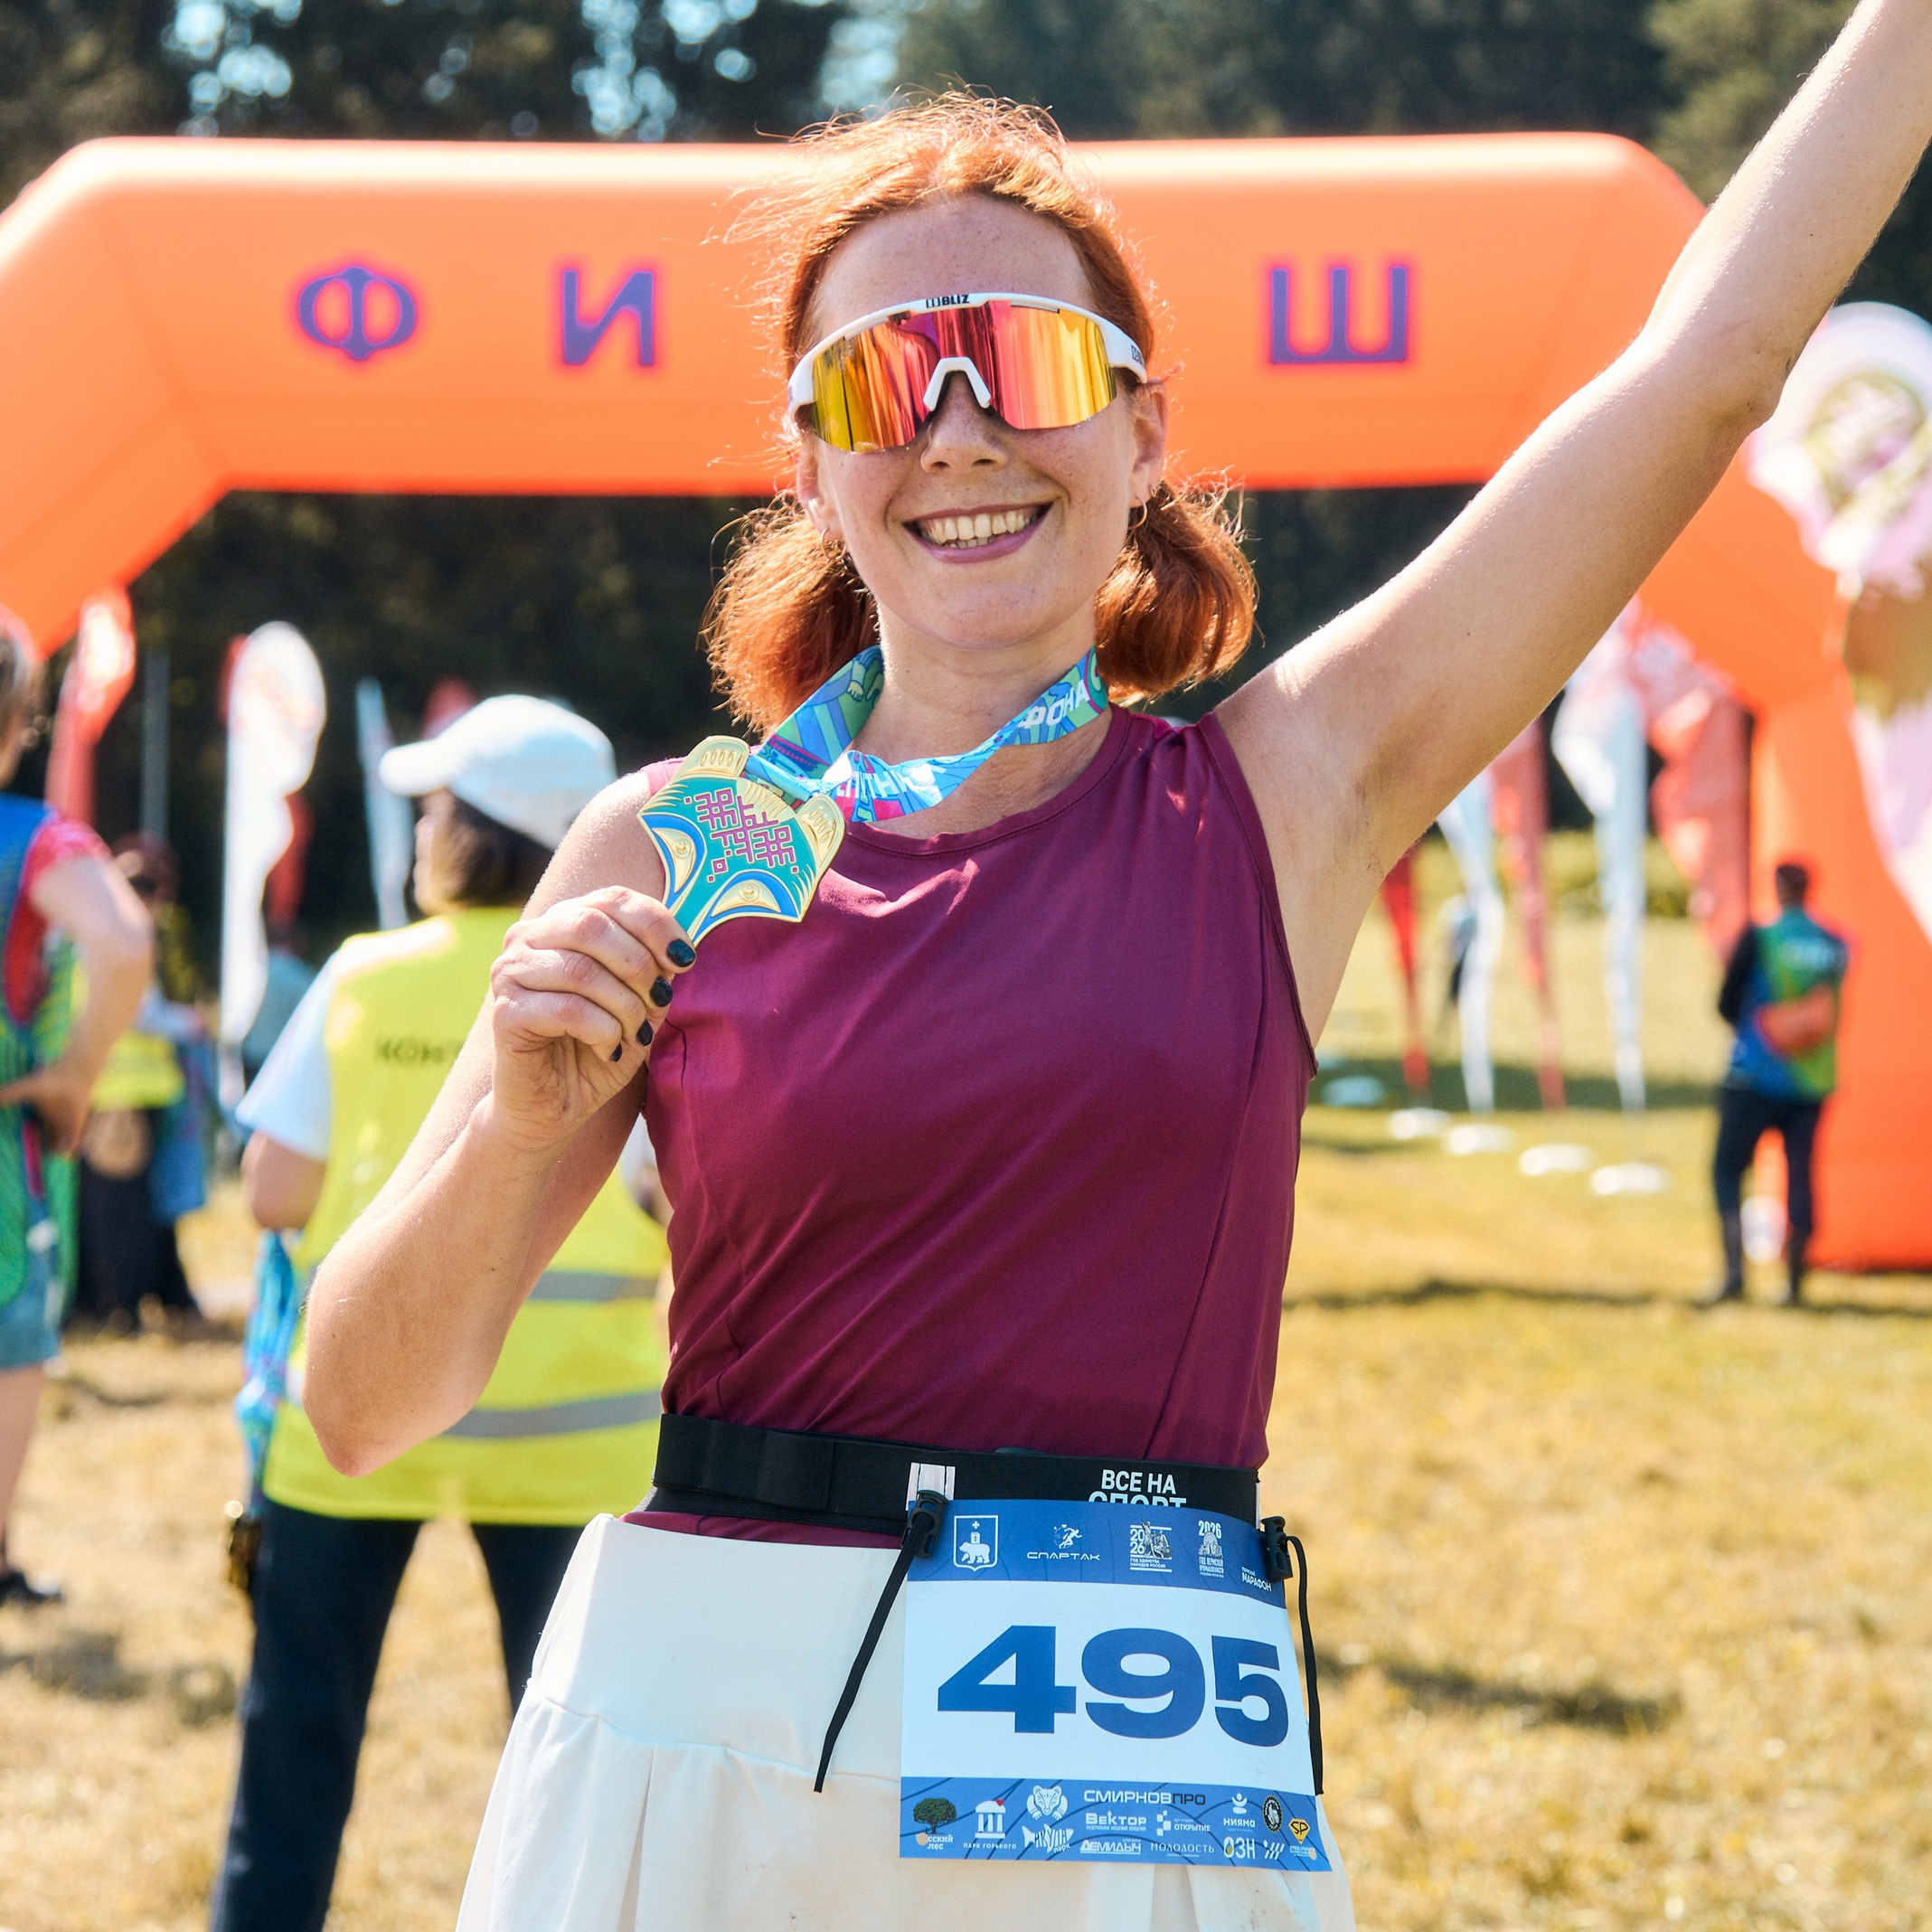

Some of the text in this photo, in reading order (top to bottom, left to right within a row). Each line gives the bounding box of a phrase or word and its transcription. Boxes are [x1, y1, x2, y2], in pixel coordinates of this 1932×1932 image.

[941, 294, 970, 306] BLIZ
[1101, 1468, 1177, 1494] ВСЕ НА
[1130, 1528, 1145, 1542] 20
[1198, 1520, 1222, 1540] 2026
[1130, 1542, 1145, 1554] 26
[1027, 1551, 1101, 1561] СПАРТАК
[1241, 1571, 1272, 1591] МАРАФОН
[938, 1625, 1289, 1748] 495
[1084, 1789, 1206, 1805] СМИРНОВПРО
[1174, 1824, 1211, 1832] ОТКРЫТИЕ
[1290, 1821, 1308, 1835] SP
[928, 1834, 954, 1843] сский
[927, 1842, 944, 1851] лес
[1053, 1842, 1071, 1853] парк
[1080, 1840, 1141, 1853] ДЕМИДЫЧ
[1151, 1842, 1215, 1853] МОЛОДОСТЬ
